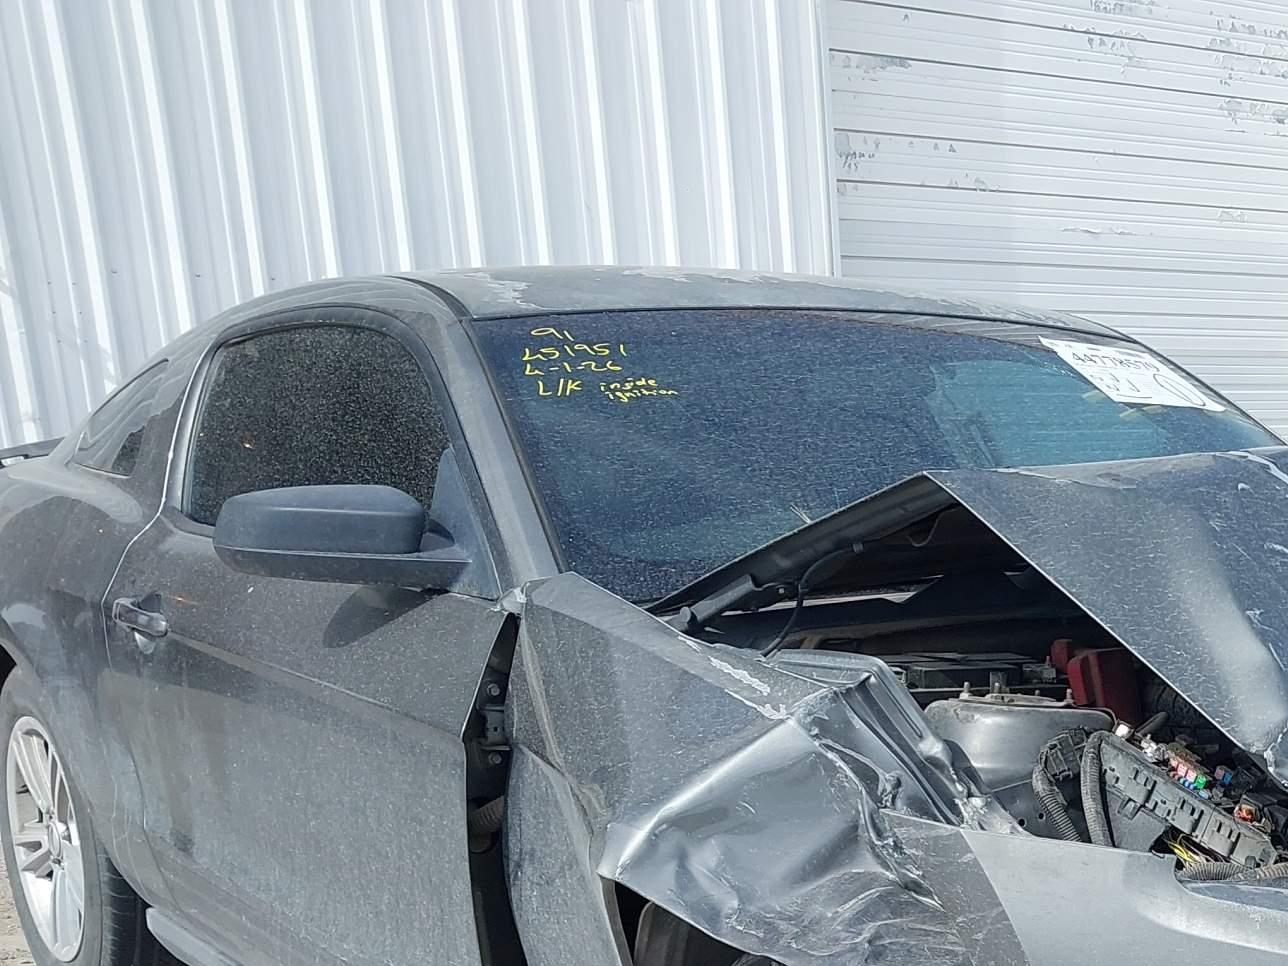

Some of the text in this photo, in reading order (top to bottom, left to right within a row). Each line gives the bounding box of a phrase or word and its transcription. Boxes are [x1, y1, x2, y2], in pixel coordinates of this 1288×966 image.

[531, 327, 575, 342] 91
[538, 377, 659, 397] L/K inside
[604, 388, 680, 403] ignition
